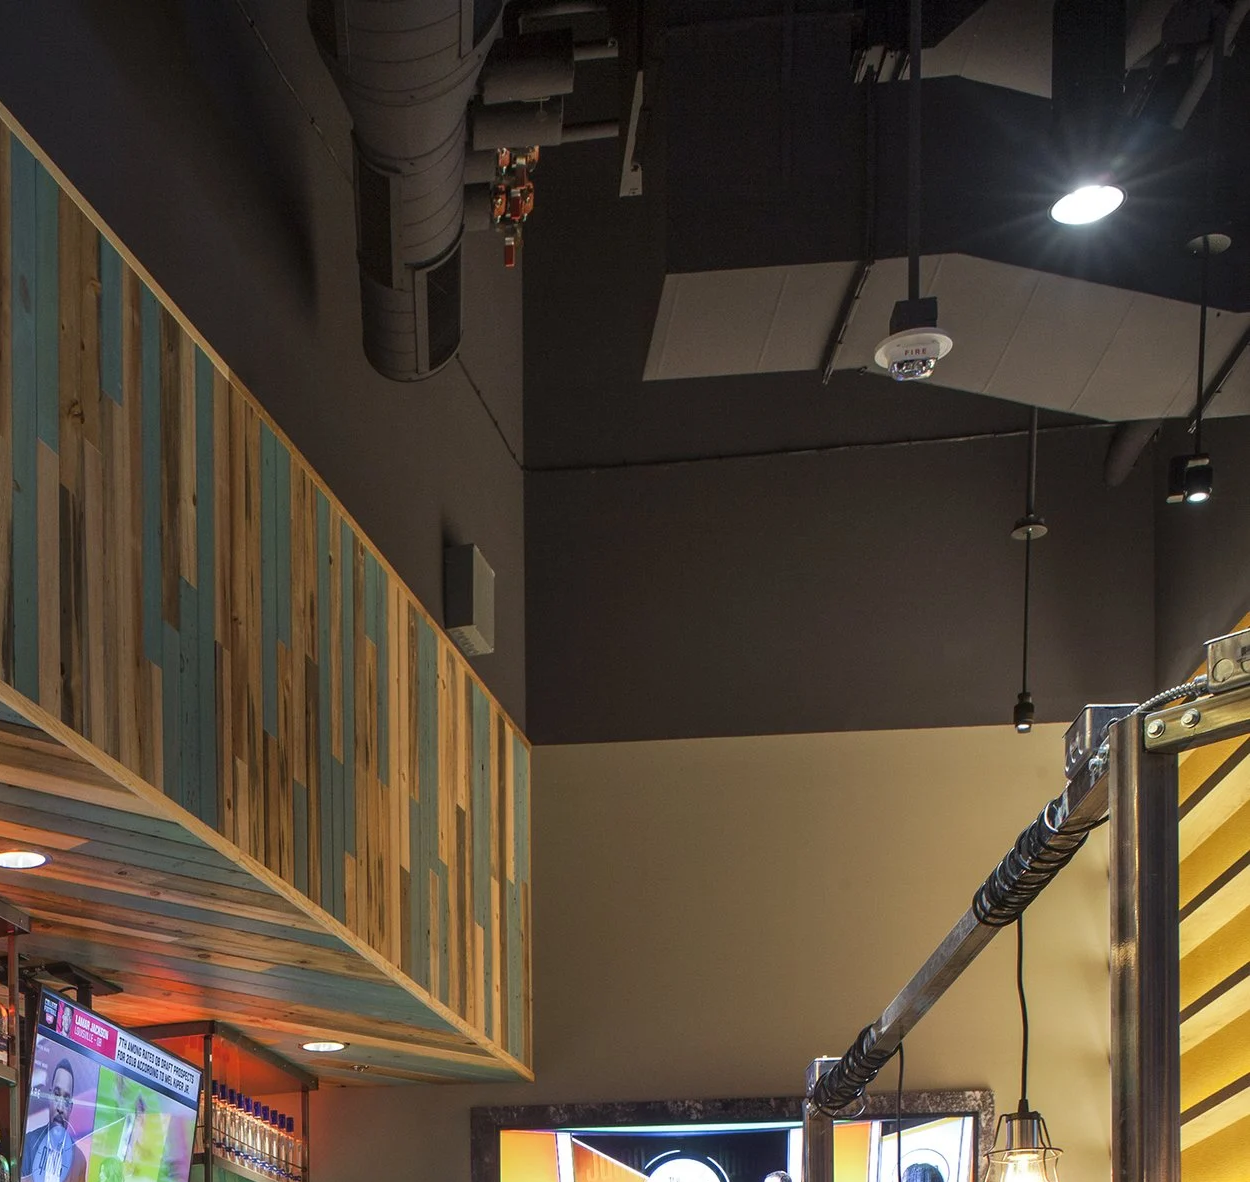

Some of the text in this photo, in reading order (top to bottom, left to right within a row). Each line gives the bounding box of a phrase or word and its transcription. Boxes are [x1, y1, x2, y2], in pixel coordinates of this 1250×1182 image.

[904, 348, 927, 356] FIRE
[75, 1014, 90, 1030] LAMAR
[117, 1050, 125, 1061] FOR
[137, 1060, 158, 1079] ACCORDING
[159, 1071, 165, 1081] TO
[173, 1078, 184, 1091] KIPER
[119, 1037, 127, 1049] 7TH
[128, 1043, 142, 1056] AMONG
[142, 1049, 155, 1064] RATED
[161, 1059, 173, 1073] DRAFT
[174, 1065, 194, 1084] PROSPECTS
